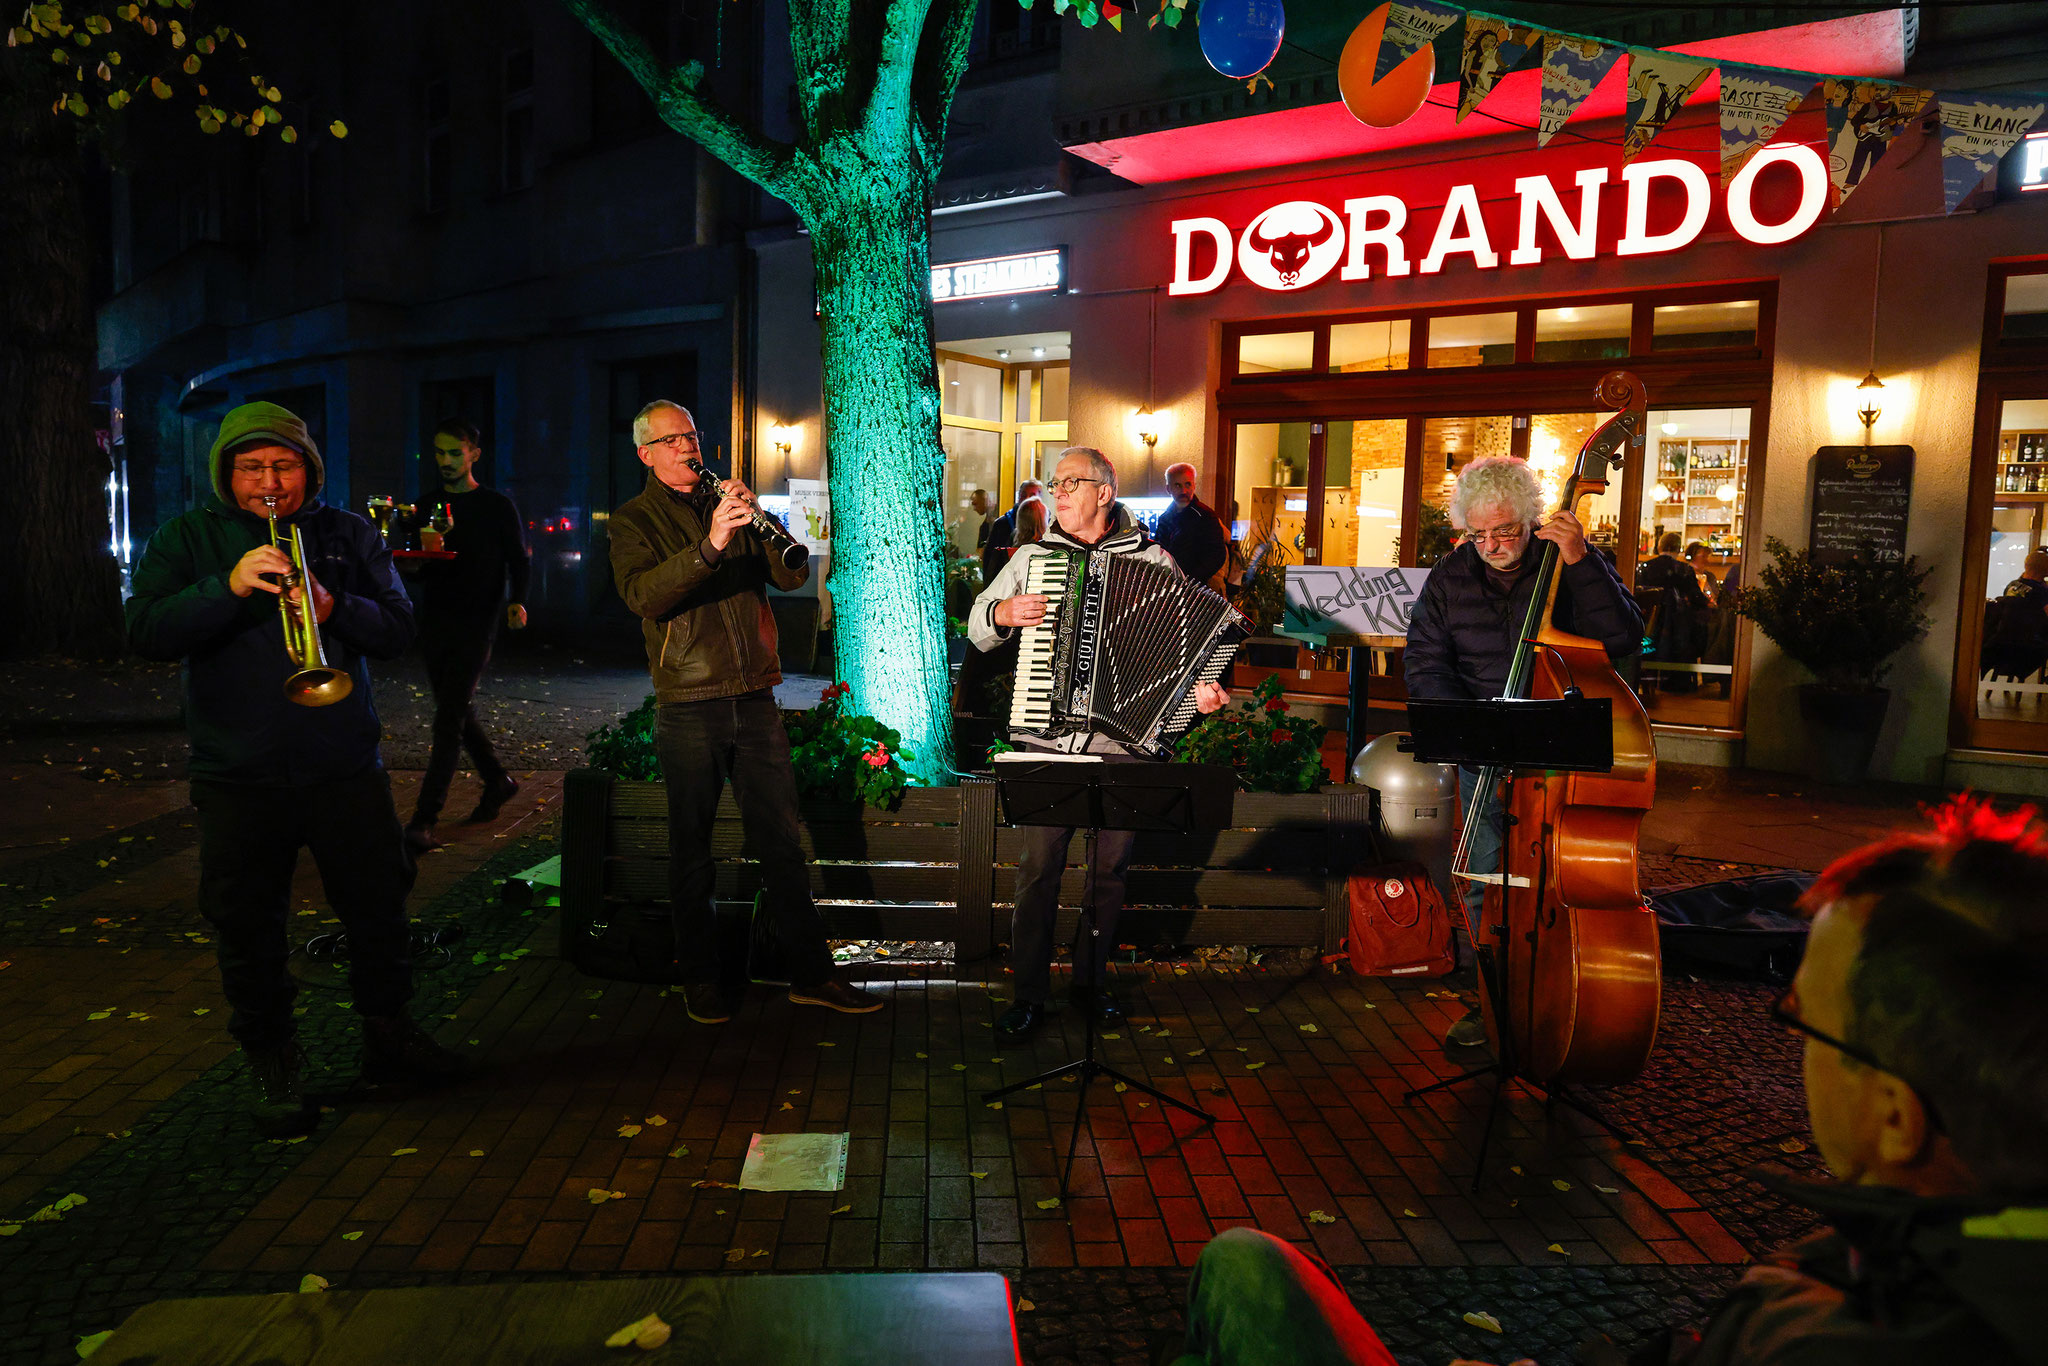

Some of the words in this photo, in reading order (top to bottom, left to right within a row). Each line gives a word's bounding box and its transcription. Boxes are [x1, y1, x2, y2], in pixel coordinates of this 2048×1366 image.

[1408, 14, 1445, 35] KLANG
[1728, 109, 1735, 117] IN
[1738, 111, 1752, 119] DER
[1973, 113, 2029, 135] KLANG
[1966, 135, 1979, 144] EIN
[1983, 138, 1998, 147] TAG
[954, 254, 1061, 296] STEAKHAUS
[1078, 591, 1099, 672] GIULIETTI
